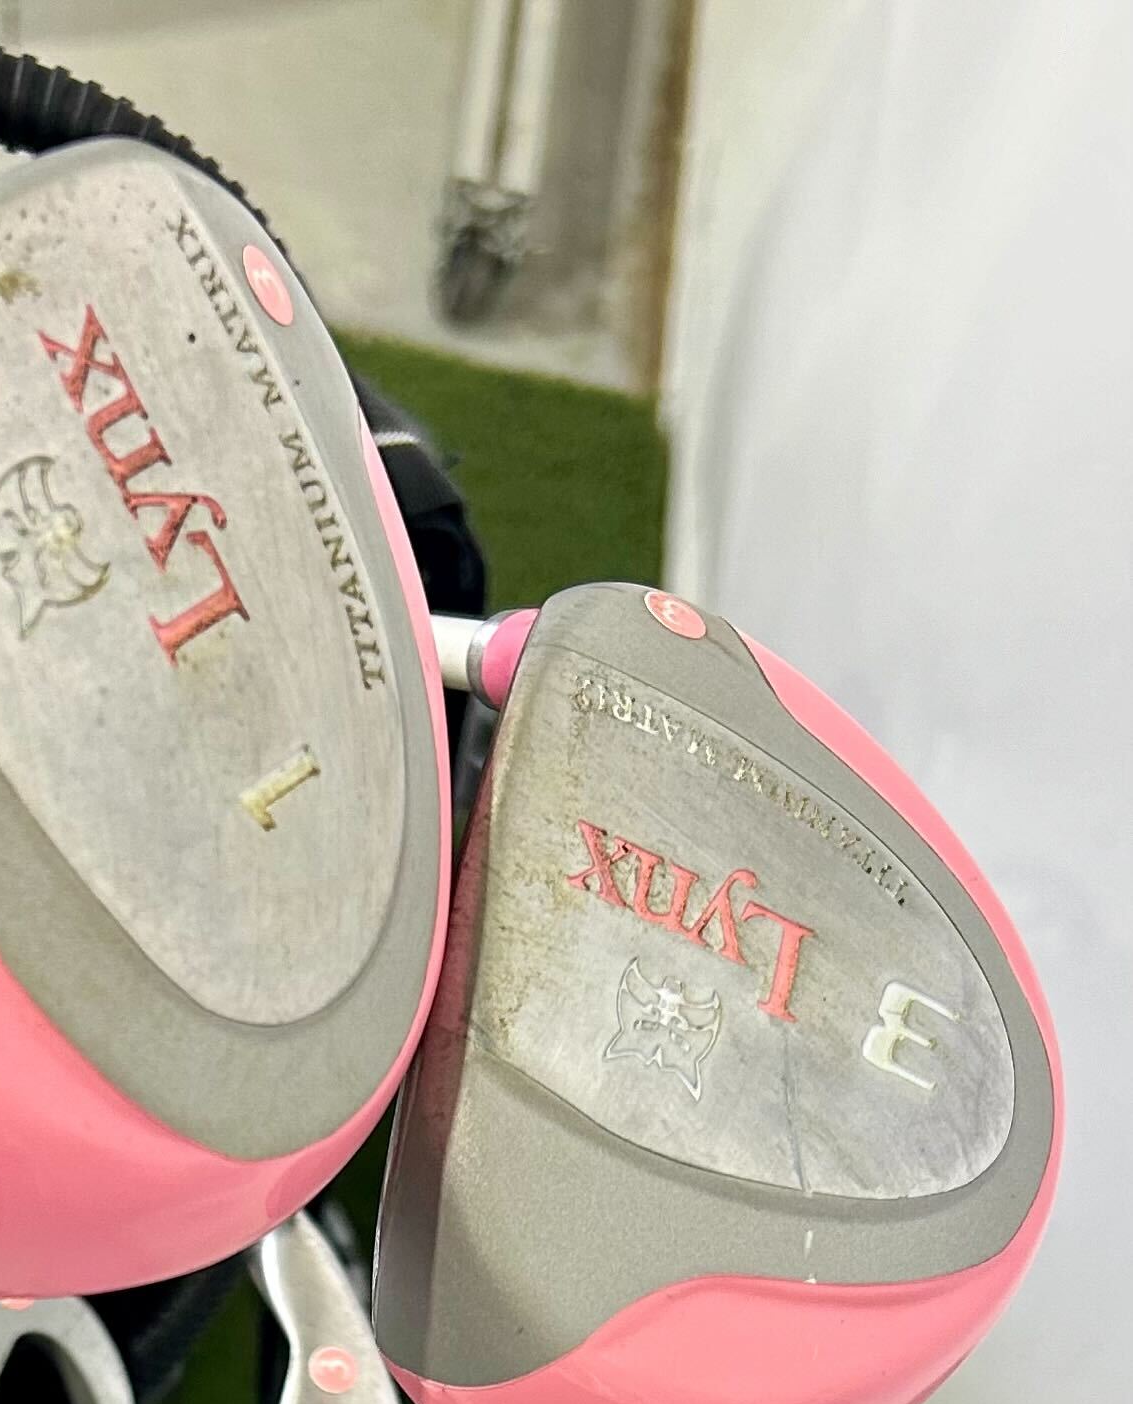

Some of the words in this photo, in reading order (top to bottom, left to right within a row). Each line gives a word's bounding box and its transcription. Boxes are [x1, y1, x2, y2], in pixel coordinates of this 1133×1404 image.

[166, 207, 285, 414] MATRIX
[37, 303, 251, 668] Lynx
[277, 425, 386, 691] TITANIUM
[240, 744, 321, 831] 1
[566, 819, 815, 1024] Lynx
[862, 979, 962, 1092] 3
